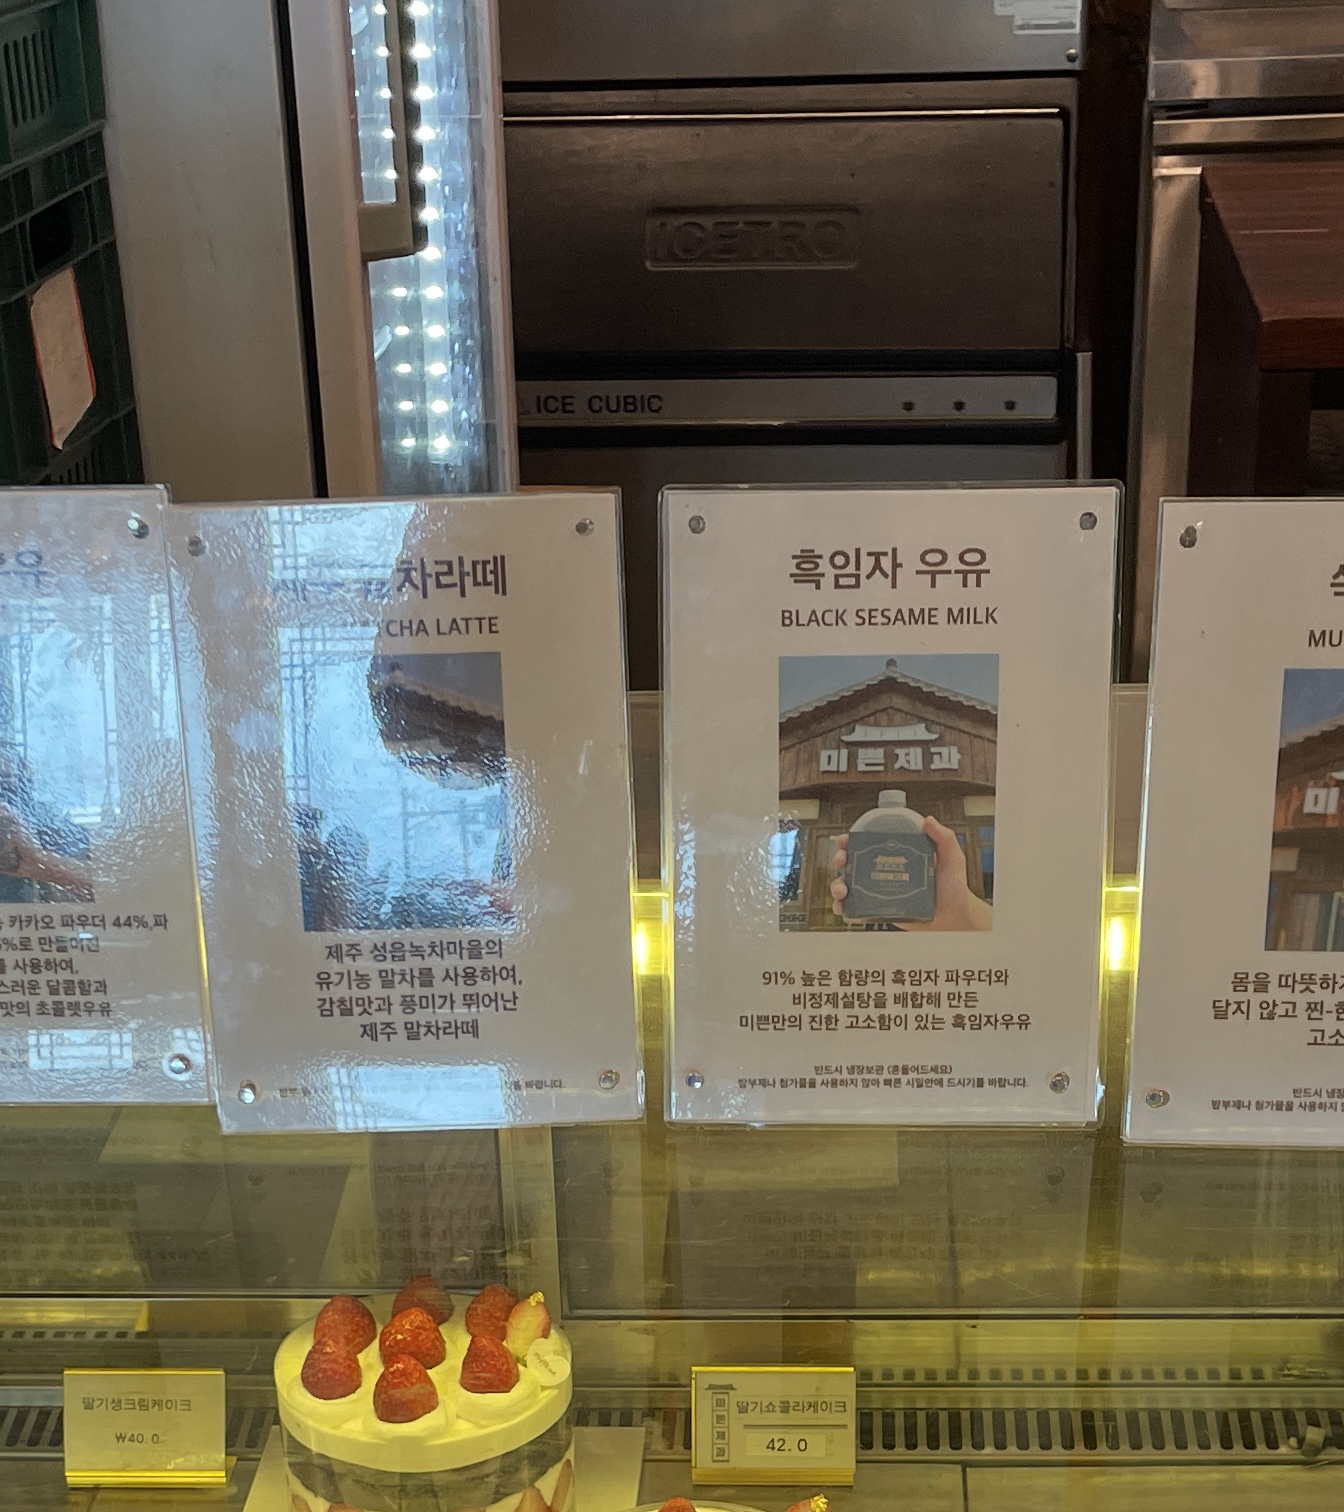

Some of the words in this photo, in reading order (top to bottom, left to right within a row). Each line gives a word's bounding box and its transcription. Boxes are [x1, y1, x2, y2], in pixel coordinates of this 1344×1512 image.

[657, 221, 848, 259] ICETRO
[536, 395, 575, 414] ICE
[588, 394, 663, 414] CUBIC
[364, 555, 507, 600] 차라떼
[789, 547, 903, 590] 흑임자
[916, 548, 991, 588] 우유
[436, 616, 499, 636] LATTE
[781, 608, 848, 627] BLACK
[854, 607, 939, 626] SESAME
[947, 606, 998, 625] MILK
[8, 914, 55, 931] 카카오
[60, 914, 105, 931] 파우더
[325, 942, 362, 965] 제주
[369, 938, 504, 963] 성읍녹차마을의
[314, 969, 373, 992] 유기농
[378, 967, 436, 989] 말차를
[762, 970, 795, 986] 91%
[800, 969, 832, 988] 높은
[838, 969, 886, 987] 함량의
[891, 969, 940, 987] 흑임자
[944, 969, 1009, 987] 파우더와
[1231, 971, 1271, 994] 몸을
[0, 1000, 31, 1018] 맛의
[316, 995, 393, 1018] 감칠맛과
[399, 993, 455, 1015] 풍미가
[461, 991, 518, 1013] 뛰어난
[792, 991, 887, 1010] 비정제설탕을
[893, 991, 941, 1010] 배합해
[946, 991, 979, 1009] 만든
[1212, 999, 1252, 1021] 달지
[1258, 1000, 1298, 1021] 않고
[359, 1021, 398, 1042] 제주
[404, 1018, 480, 1041] 말차라떼
[739, 1013, 802, 1032] 미쁜만의
[808, 1013, 839, 1032] 진한
[845, 1014, 908, 1032] 고소함이
[914, 1013, 946, 1032] 있는
[951, 1013, 1031, 1032] 흑임자우유
[82, 1397, 193, 1412] 딸기생크림케이크
[736, 1400, 847, 1414] 딸기쇼콜라케이크
